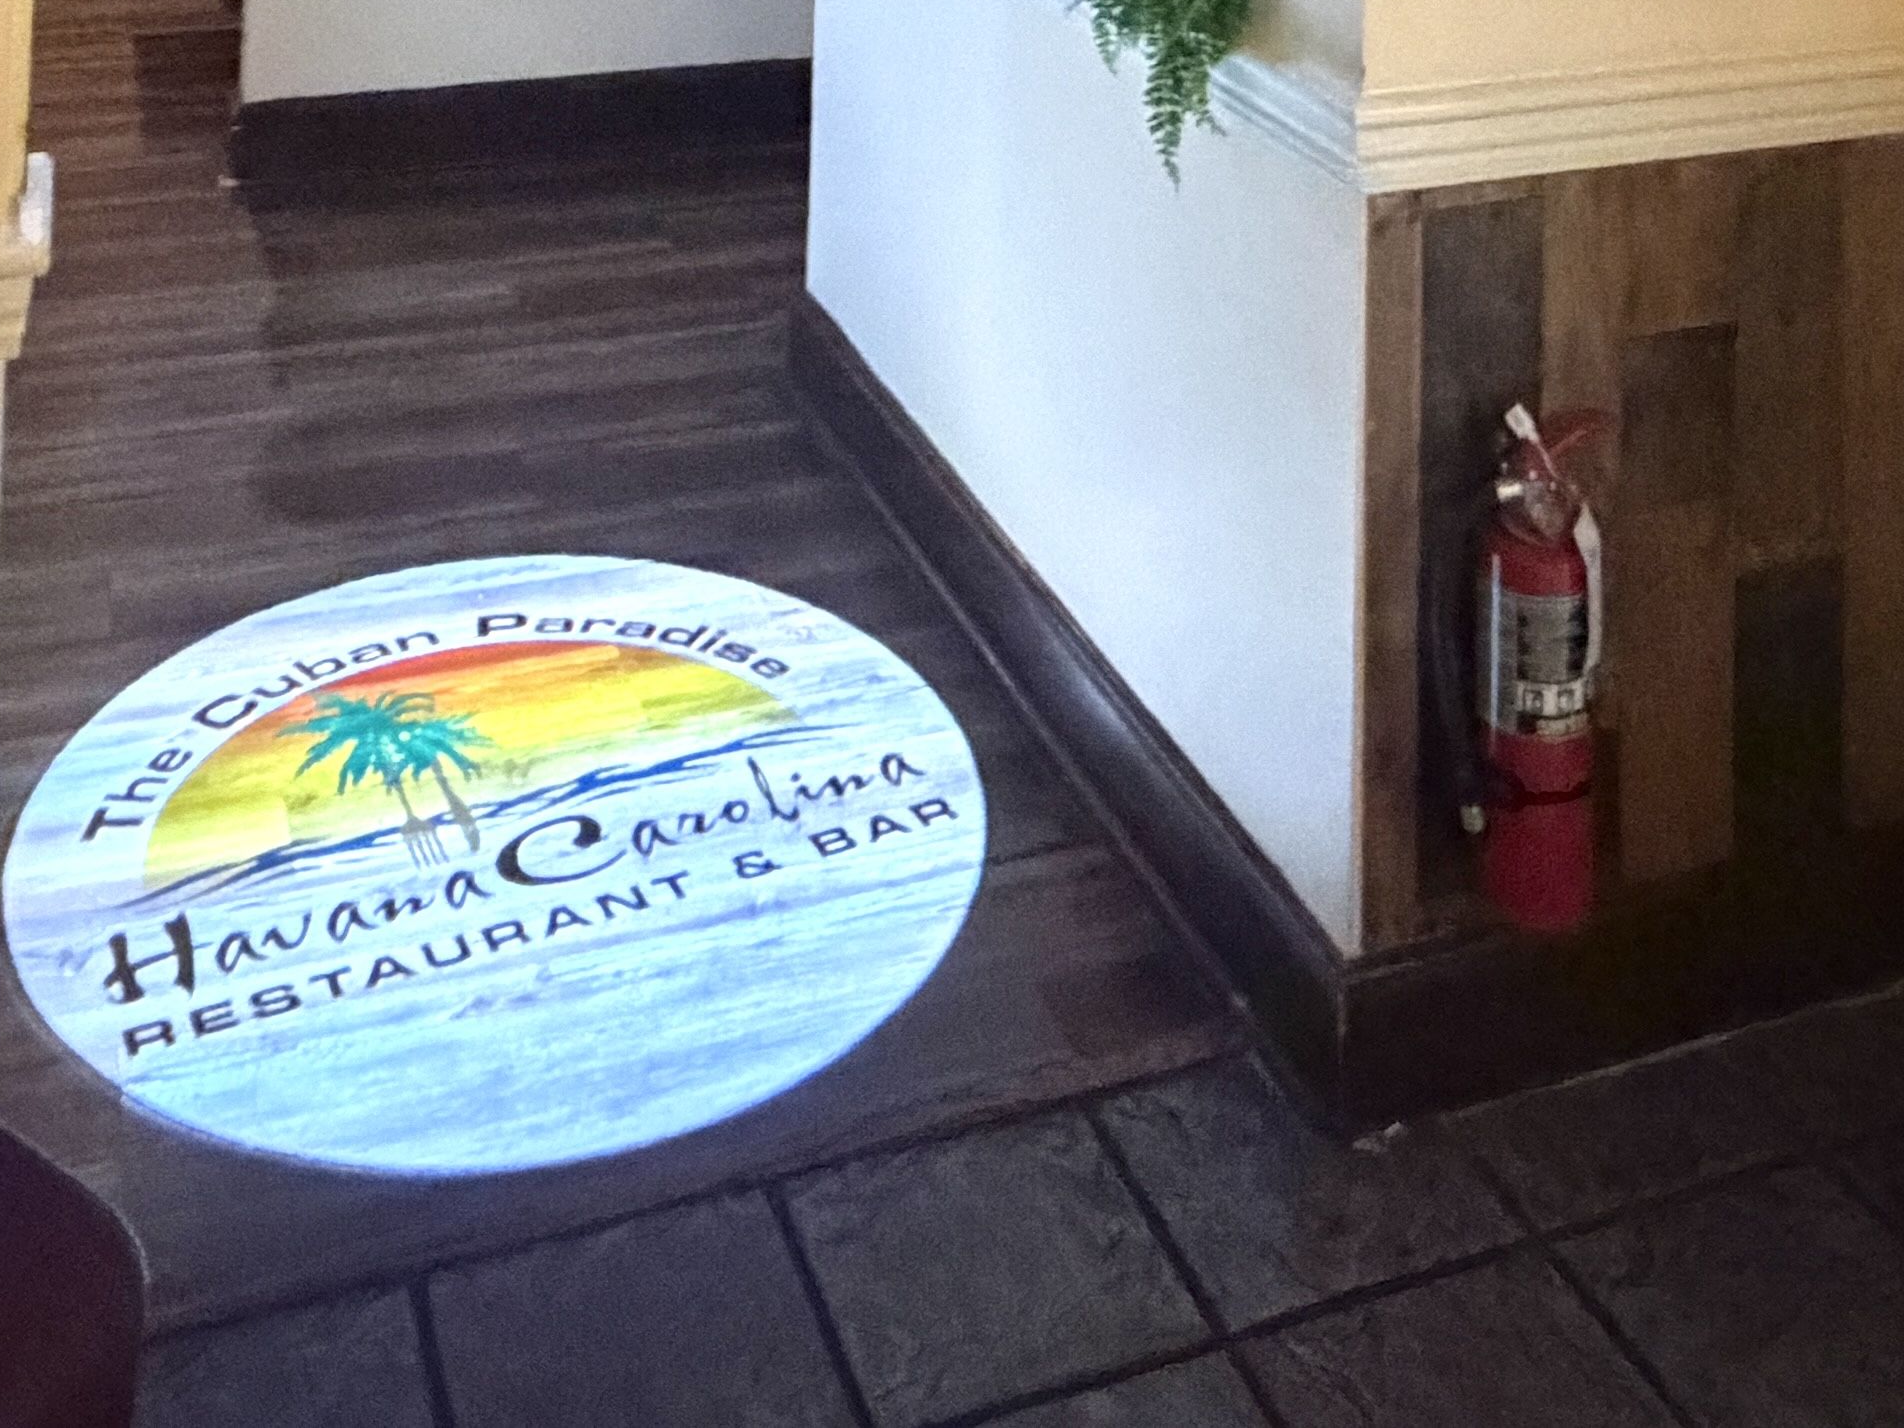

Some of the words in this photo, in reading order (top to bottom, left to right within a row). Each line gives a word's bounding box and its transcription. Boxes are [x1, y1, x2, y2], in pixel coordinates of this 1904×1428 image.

[80, 747, 194, 842] The
[192, 630, 440, 729] Cuban
[476, 612, 791, 679] Paradise
[102, 870, 494, 1004] Havana
[496, 752, 926, 886] Carolina
[121, 871, 689, 1057] RESTAURANT
[732, 850, 783, 879] &
[809, 796, 960, 857] BAR
